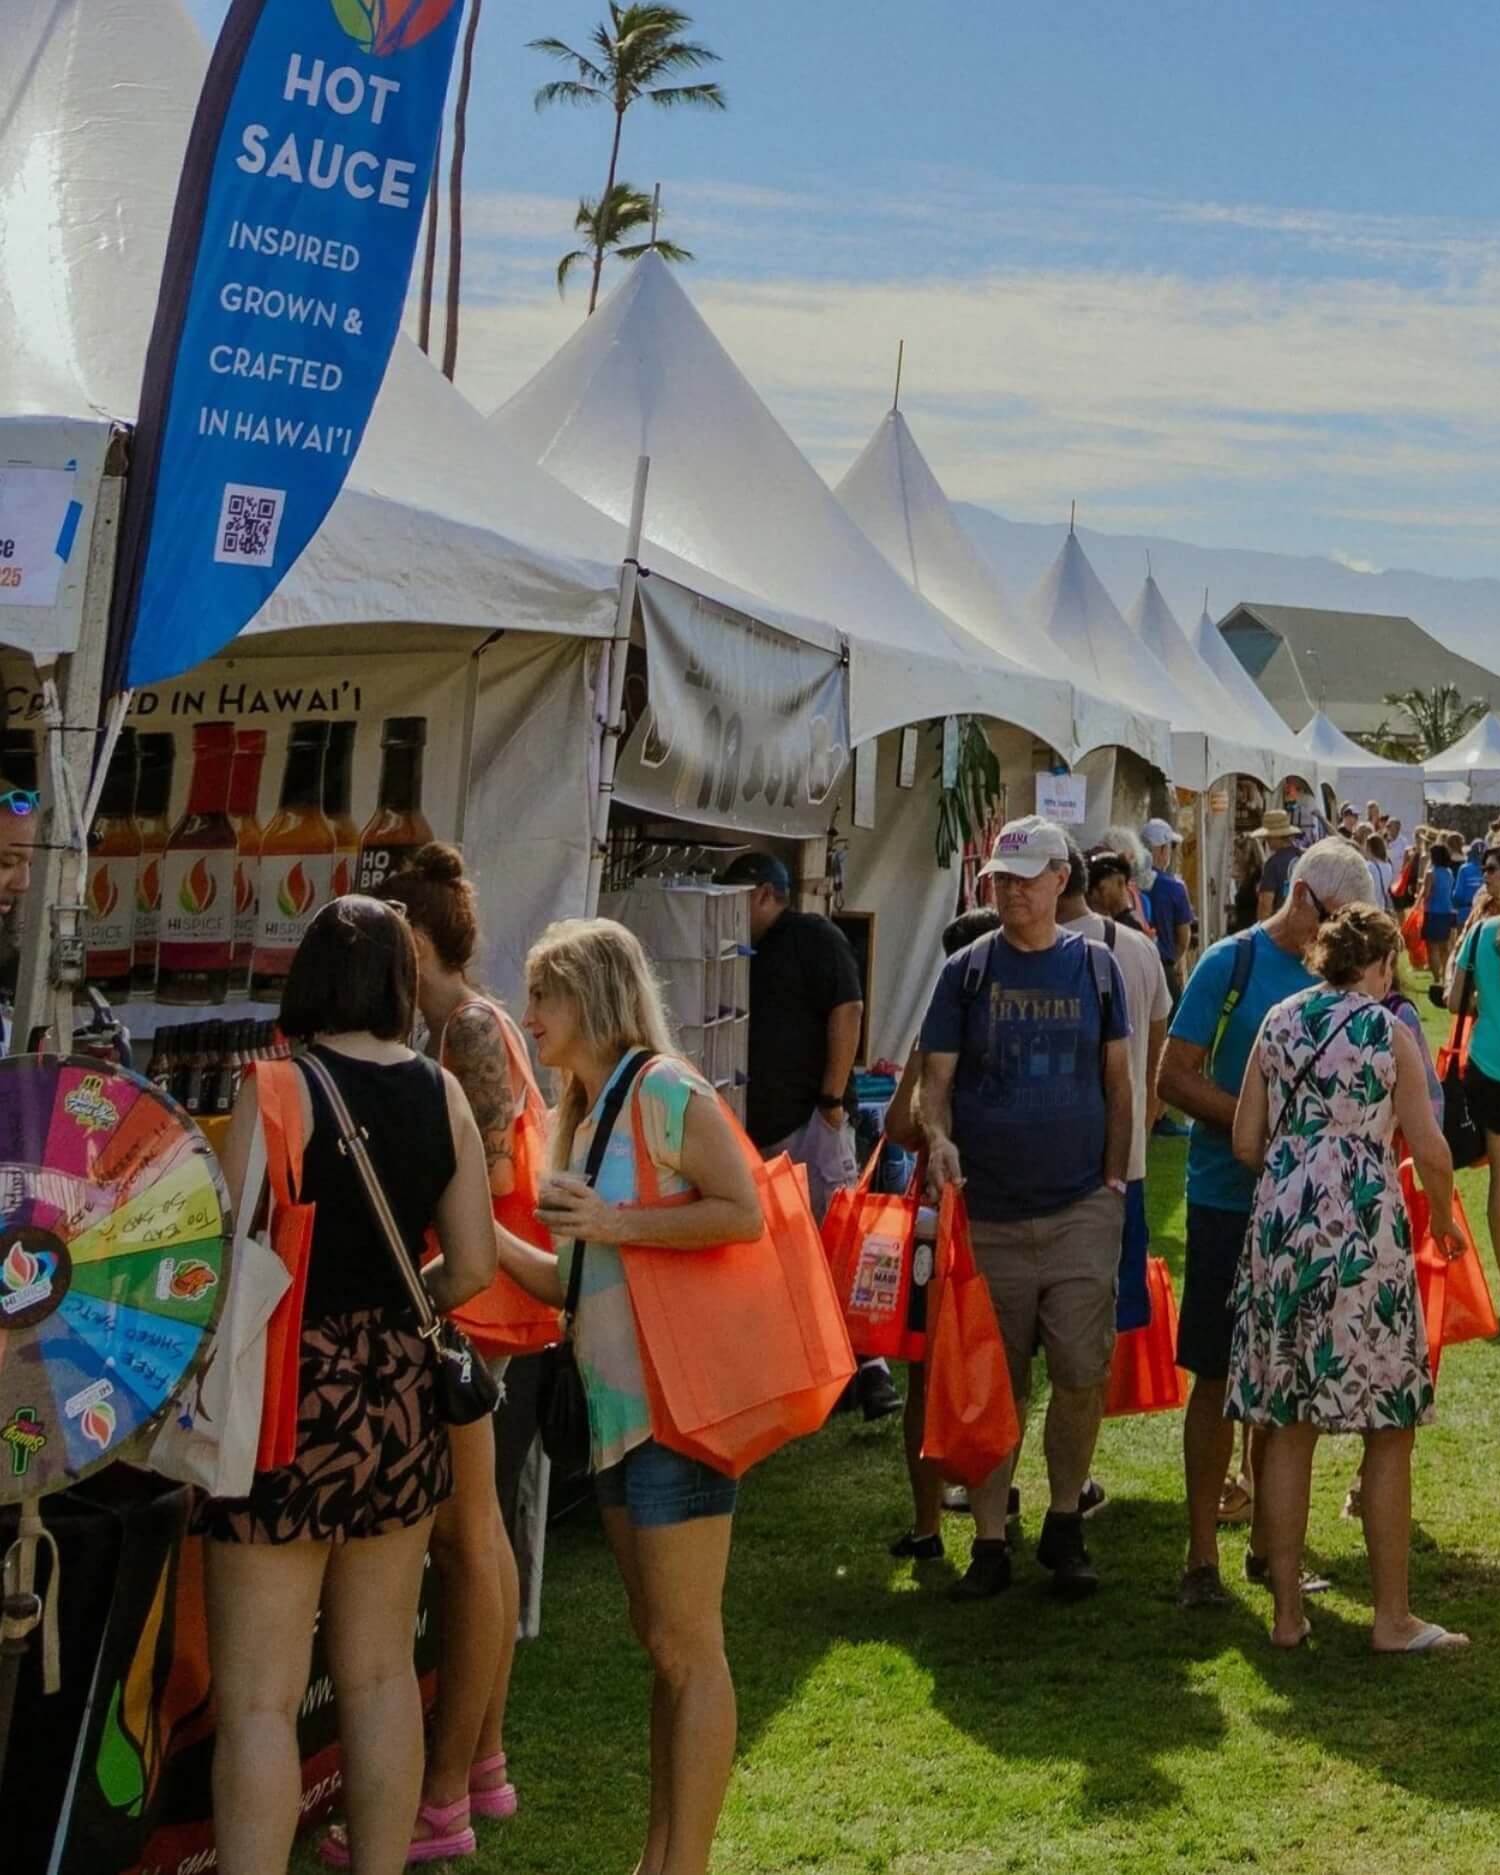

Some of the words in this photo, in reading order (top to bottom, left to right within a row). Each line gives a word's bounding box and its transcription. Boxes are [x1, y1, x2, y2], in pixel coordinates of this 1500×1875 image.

[284, 53, 400, 125] HOT
[236, 125, 416, 209] SAUCE
[229, 221, 359, 272] INSPIRED
[220, 283, 335, 328] GROWN
[343, 308, 363, 335] &
[209, 345, 342, 391] CRAFTED
[200, 407, 227, 437] IN
[0, 567, 22, 587] 25
[362, 851, 390, 868] HO
